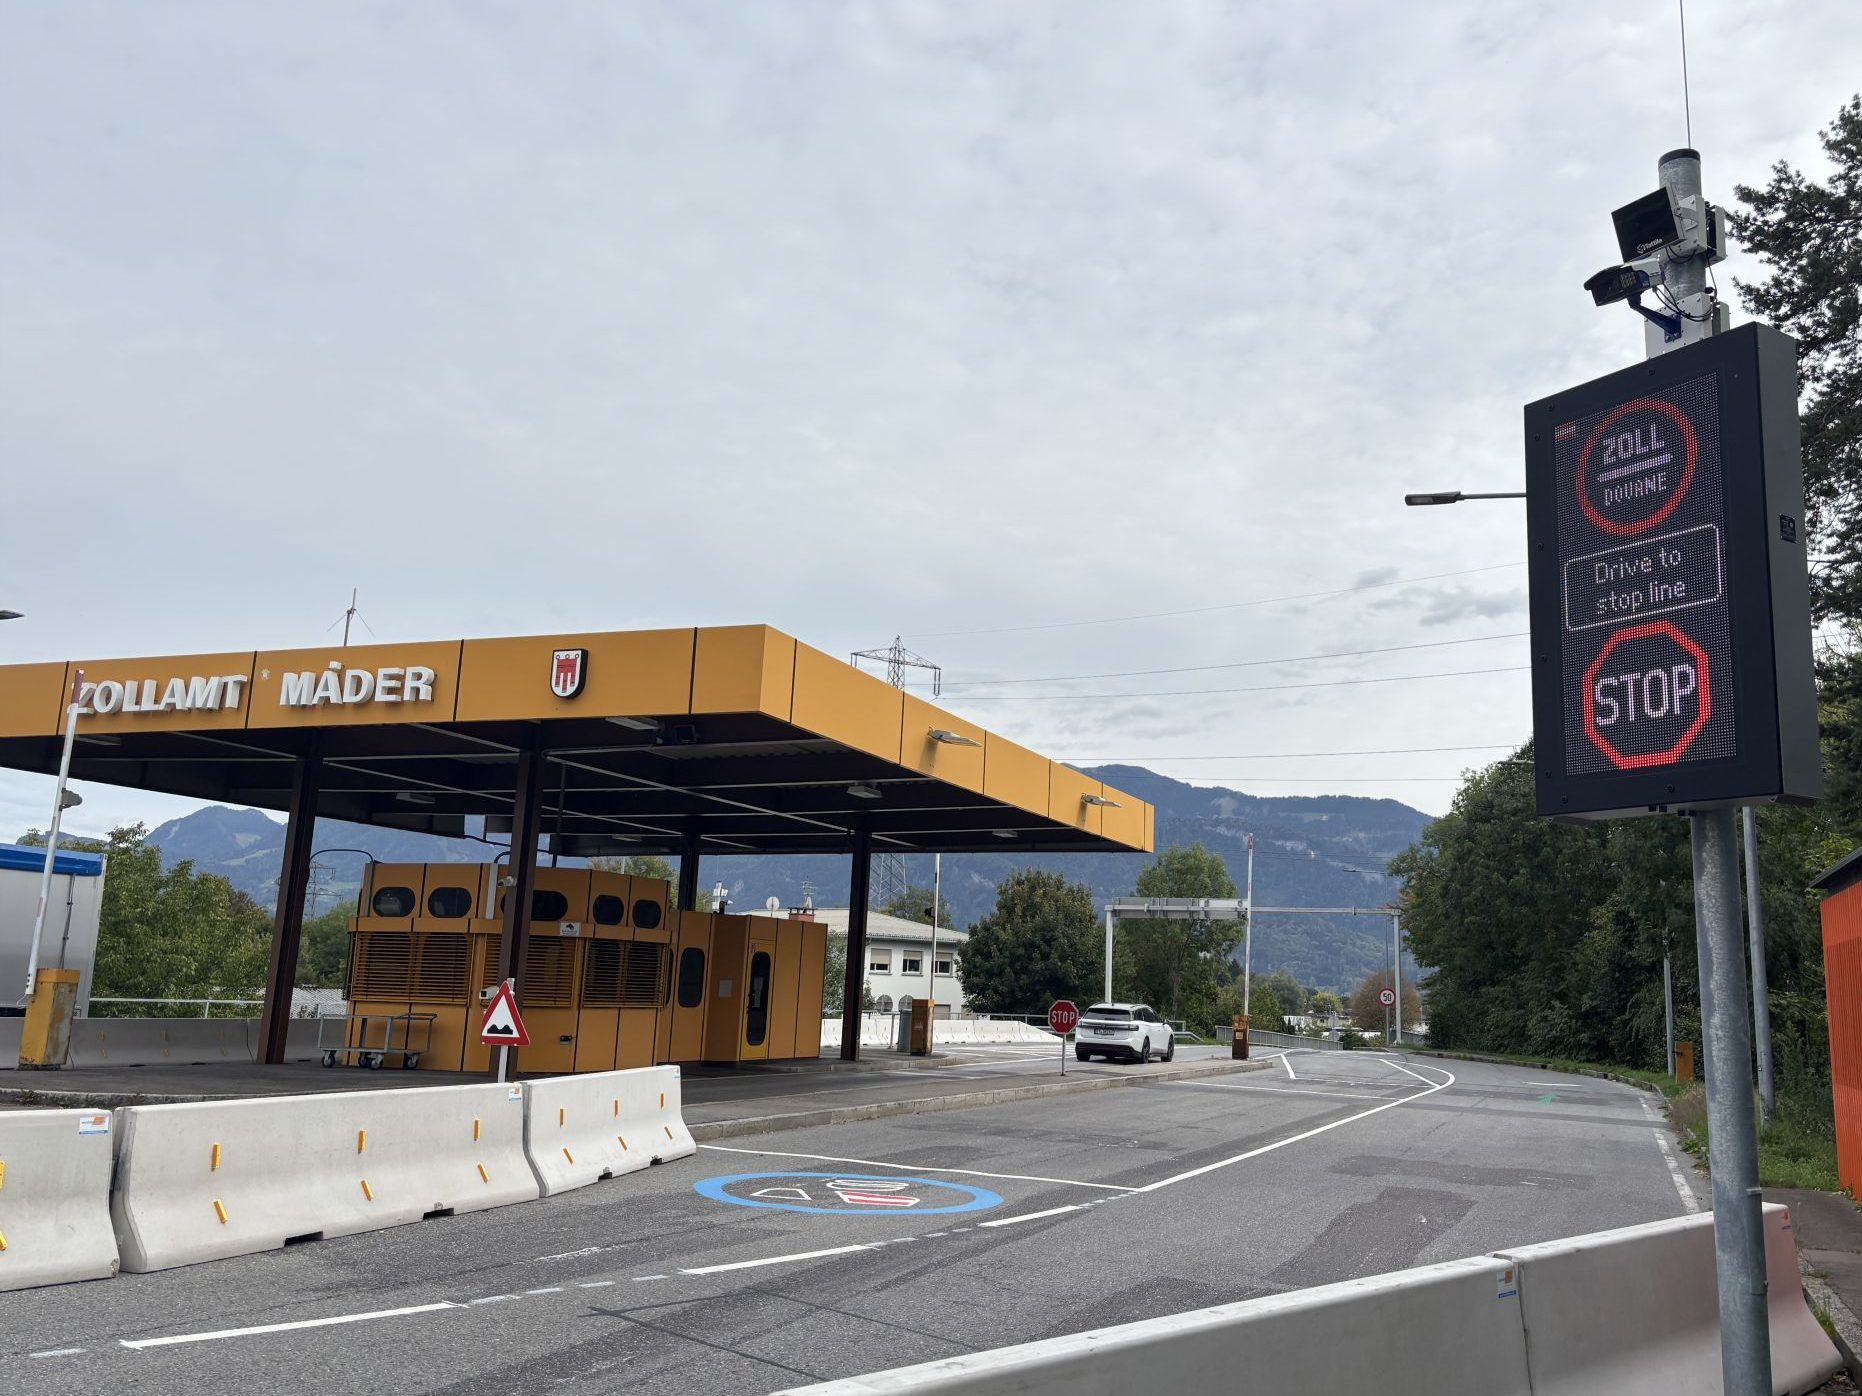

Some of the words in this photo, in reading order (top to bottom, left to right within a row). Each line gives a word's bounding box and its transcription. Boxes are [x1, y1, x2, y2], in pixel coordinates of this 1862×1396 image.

[1603, 424, 1665, 465] ZOLL
[1604, 471, 1667, 506] DOUANE
[1595, 557, 1652, 584] Drive
[1659, 547, 1682, 567] to
[1596, 591, 1643, 614] stop
[1649, 580, 1686, 603] line
[279, 660, 437, 706] MÄDER
[1594, 663, 1696, 726] STOP
[1382, 992, 1392, 1002] 50
[1051, 1010, 1075, 1024] STOP
